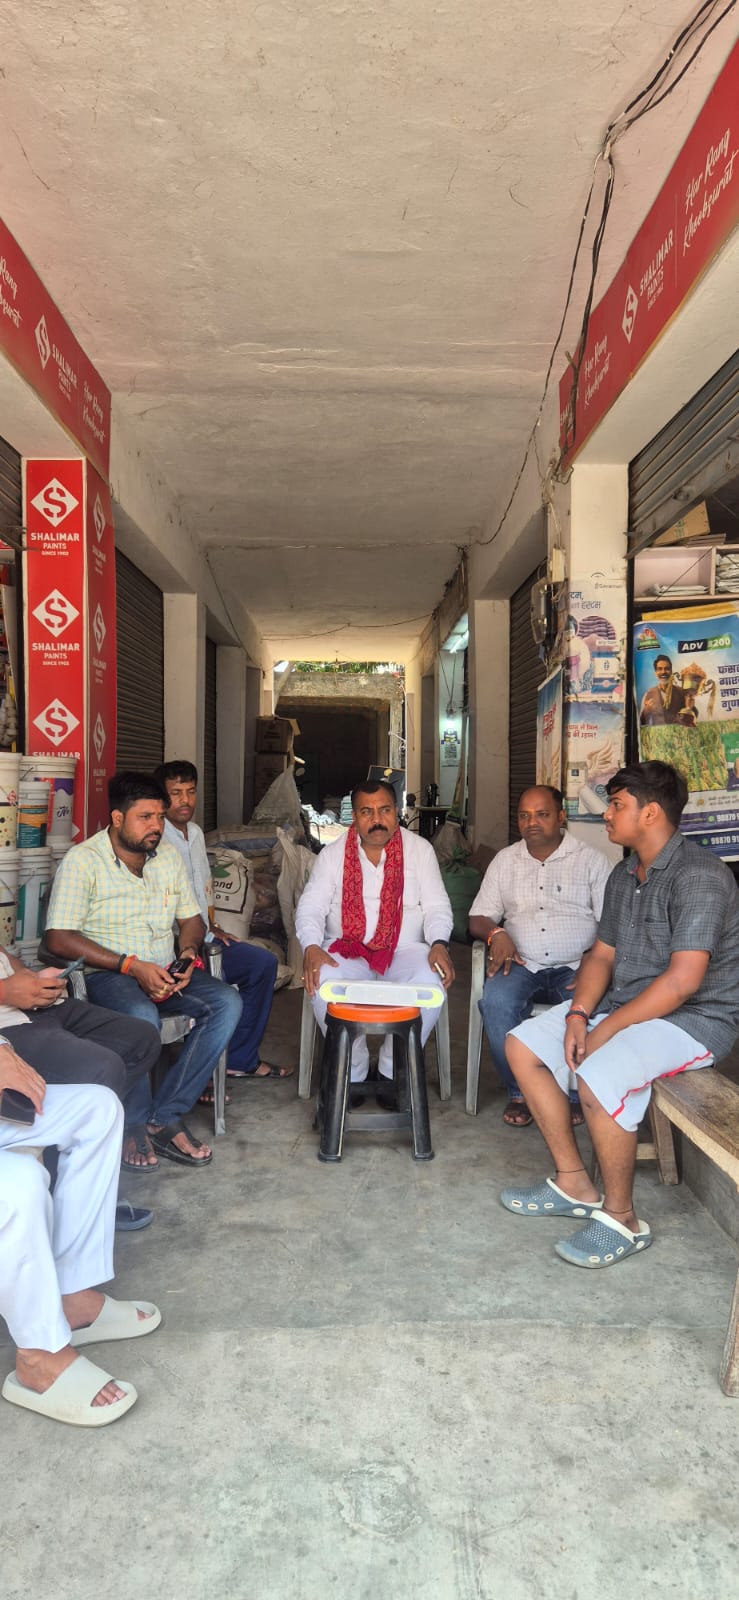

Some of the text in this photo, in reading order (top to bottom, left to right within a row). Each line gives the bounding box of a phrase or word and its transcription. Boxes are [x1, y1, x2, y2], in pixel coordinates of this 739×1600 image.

[685, 127, 730, 214] Har Rang
[683, 149, 739, 256] Khoobsurat
[640, 229, 673, 297] SHALIMAR
[647, 265, 664, 301] PAINTS
[52, 344, 78, 389] SHALIMAR
[30, 532, 80, 542] SHALIMAR
[43, 542, 67, 550] PAINTS
[32, 642, 80, 651] SHALIMAR
[681, 641, 704, 651] ADV
[718, 675, 739, 686] गाए
[720, 687, 739, 698] सफ
[32, 751, 81, 760] SHALIMAR
